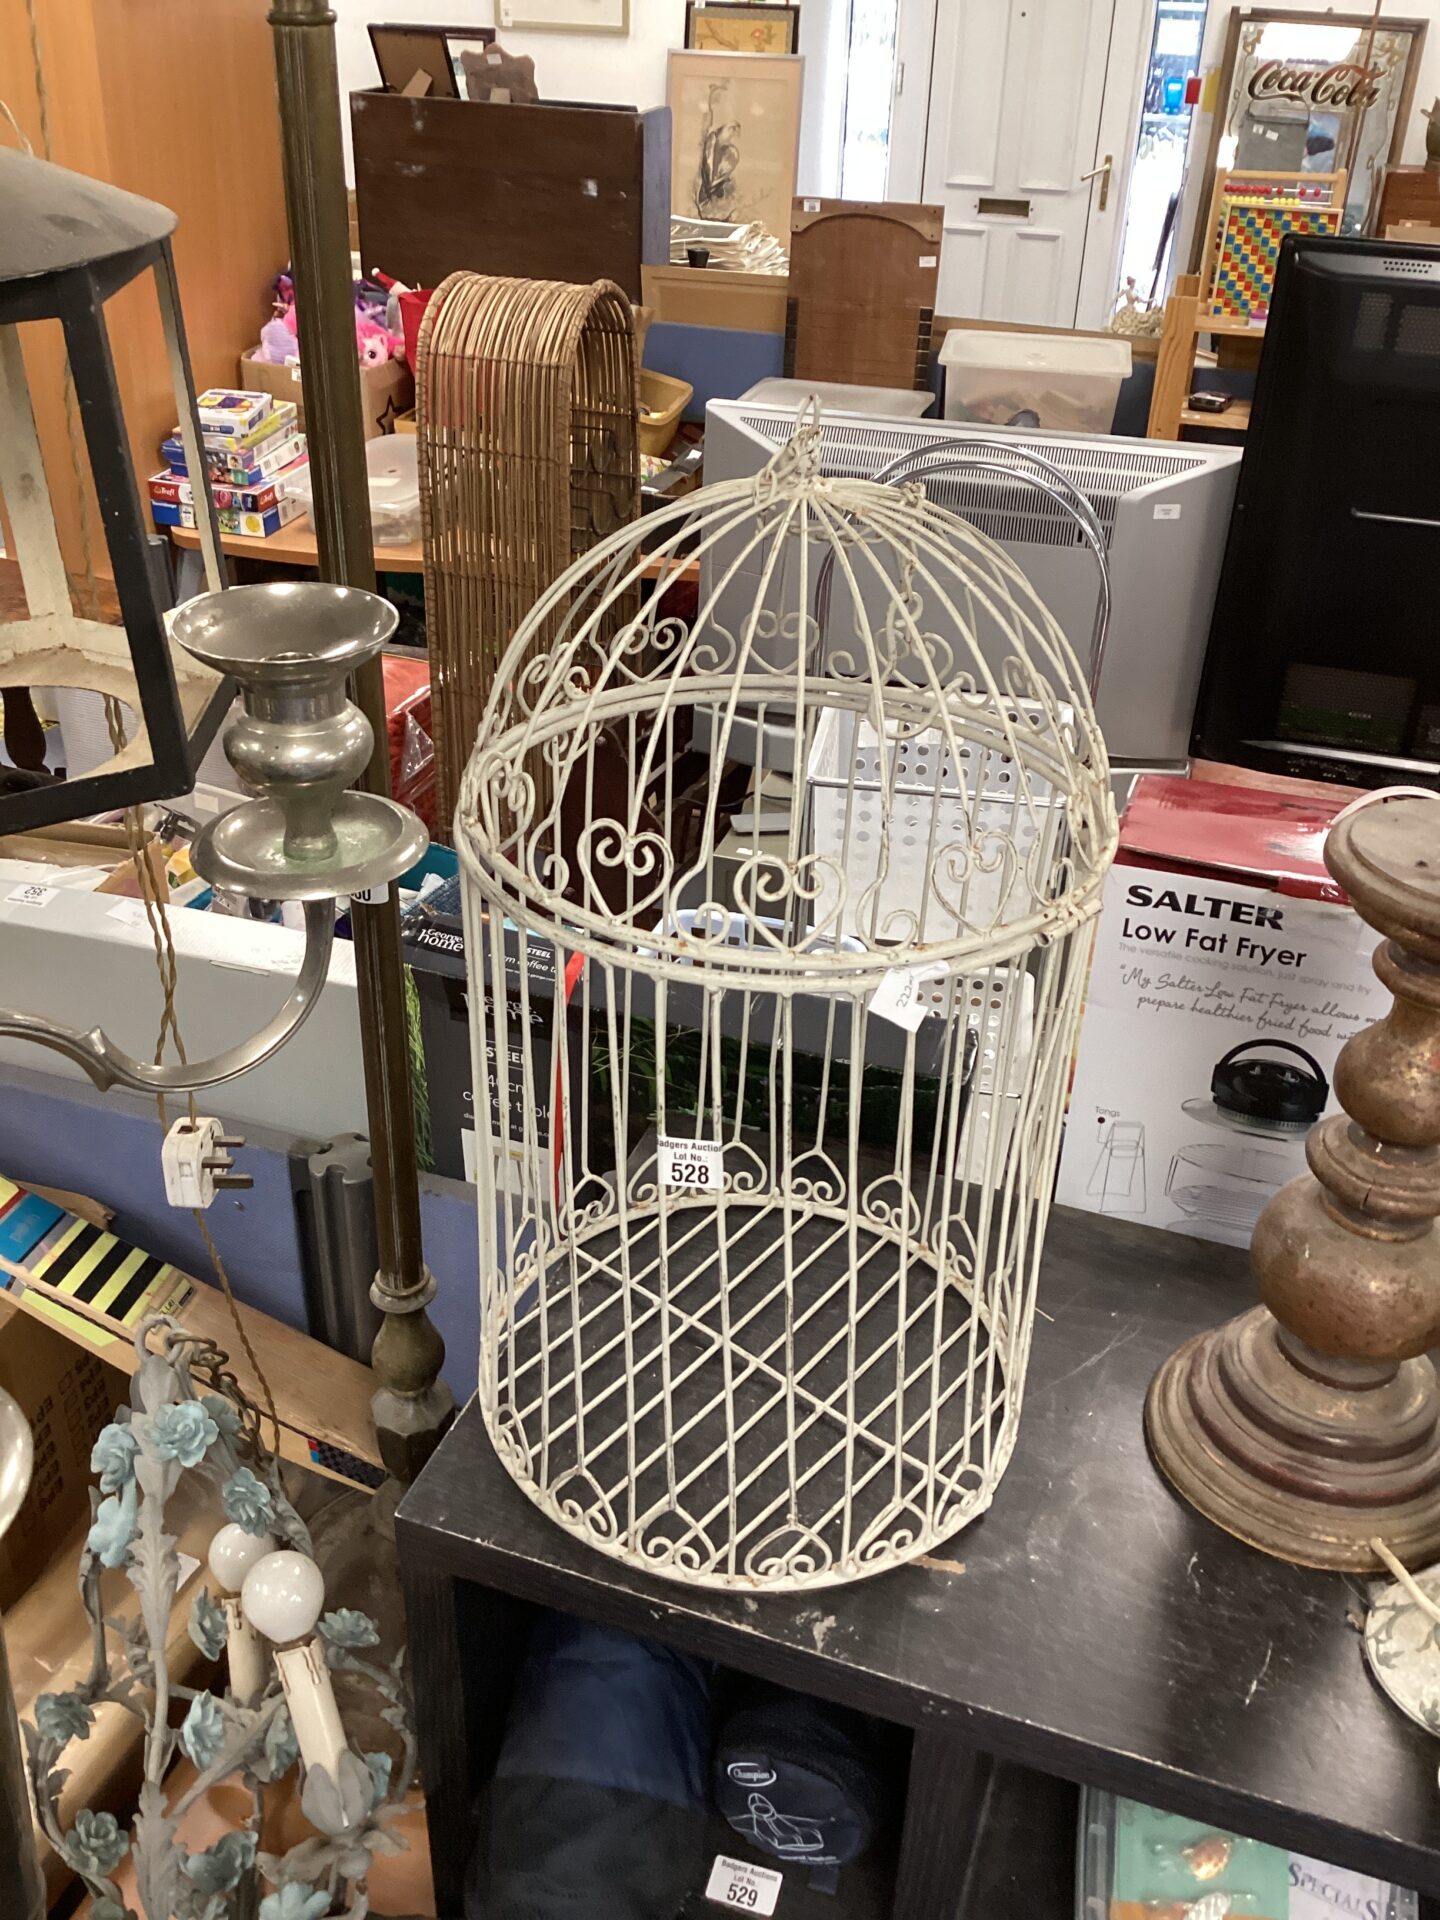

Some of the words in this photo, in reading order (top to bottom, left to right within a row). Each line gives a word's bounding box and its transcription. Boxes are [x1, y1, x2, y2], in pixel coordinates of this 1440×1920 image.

[1126, 885, 1284, 930] SALTER
[417, 928, 464, 952] home
[1122, 918, 1176, 944] Low
[1185, 928, 1228, 954] Fat
[1236, 937, 1307, 967] Fryer
[526, 947, 551, 959] STEEL
[1119, 942, 1137, 953] The
[1185, 954, 1230, 970] cooking
[1155, 973, 1204, 992] Salter
[1204, 981, 1234, 999] Low
[1240, 987, 1269, 1003] Fat
[1269, 993, 1307, 1014] Fryer
[1311, 1001, 1360, 1021] allows
[1137, 996, 1185, 1012] prepare
[1190, 997, 1255, 1022] healthier
[1256, 1010, 1295, 1031] fried
[1298, 1018, 1333, 1038] food
[1095, 1105, 1120, 1118] Tongs
[658, 1140, 689, 1150] adgers
[674, 1152, 687, 1160] Lot
[671, 1162, 709, 1184] 528
[721, 1859, 748, 1873] Badgers
[750, 1868, 778, 1882] Auctions
[734, 1874, 744, 1882] Lot
[727, 1883, 758, 1907] 529
